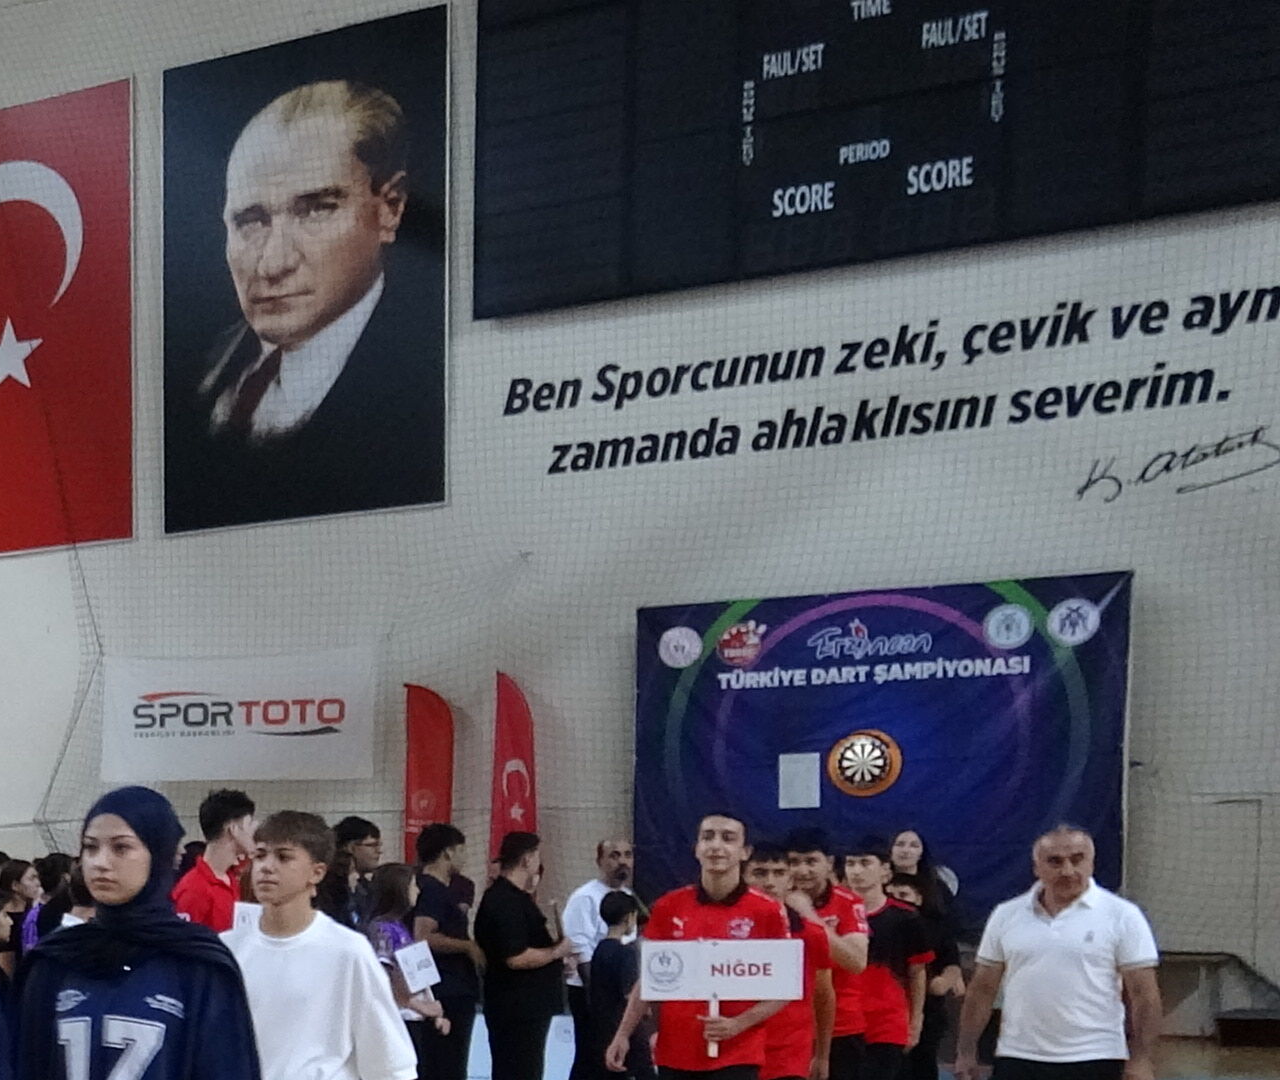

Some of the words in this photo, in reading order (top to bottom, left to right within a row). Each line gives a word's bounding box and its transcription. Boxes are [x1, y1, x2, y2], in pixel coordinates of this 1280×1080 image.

[851, 0, 891, 21] TIME
[922, 11, 989, 49] FAUL/SET
[762, 43, 825, 80] FAUL/SET
[840, 139, 890, 165] PERIOD
[907, 156, 974, 195] SCORE
[772, 181, 835, 218] SCORE
[502, 376, 581, 417] Ben
[591, 346, 825, 404] Sporcunun
[834, 319, 948, 375] zeki,
[961, 301, 1097, 362] çevik
[1111, 300, 1169, 340] ve
[547, 417, 739, 475] zamanda
[751, 394, 995, 453] ahlaklısını
[1008, 362, 1231, 425] severim.
[717, 664, 806, 690] TÜRKİYE
[811, 665, 870, 686] DART
[873, 655, 1031, 686] ŞAMPİYONASI
